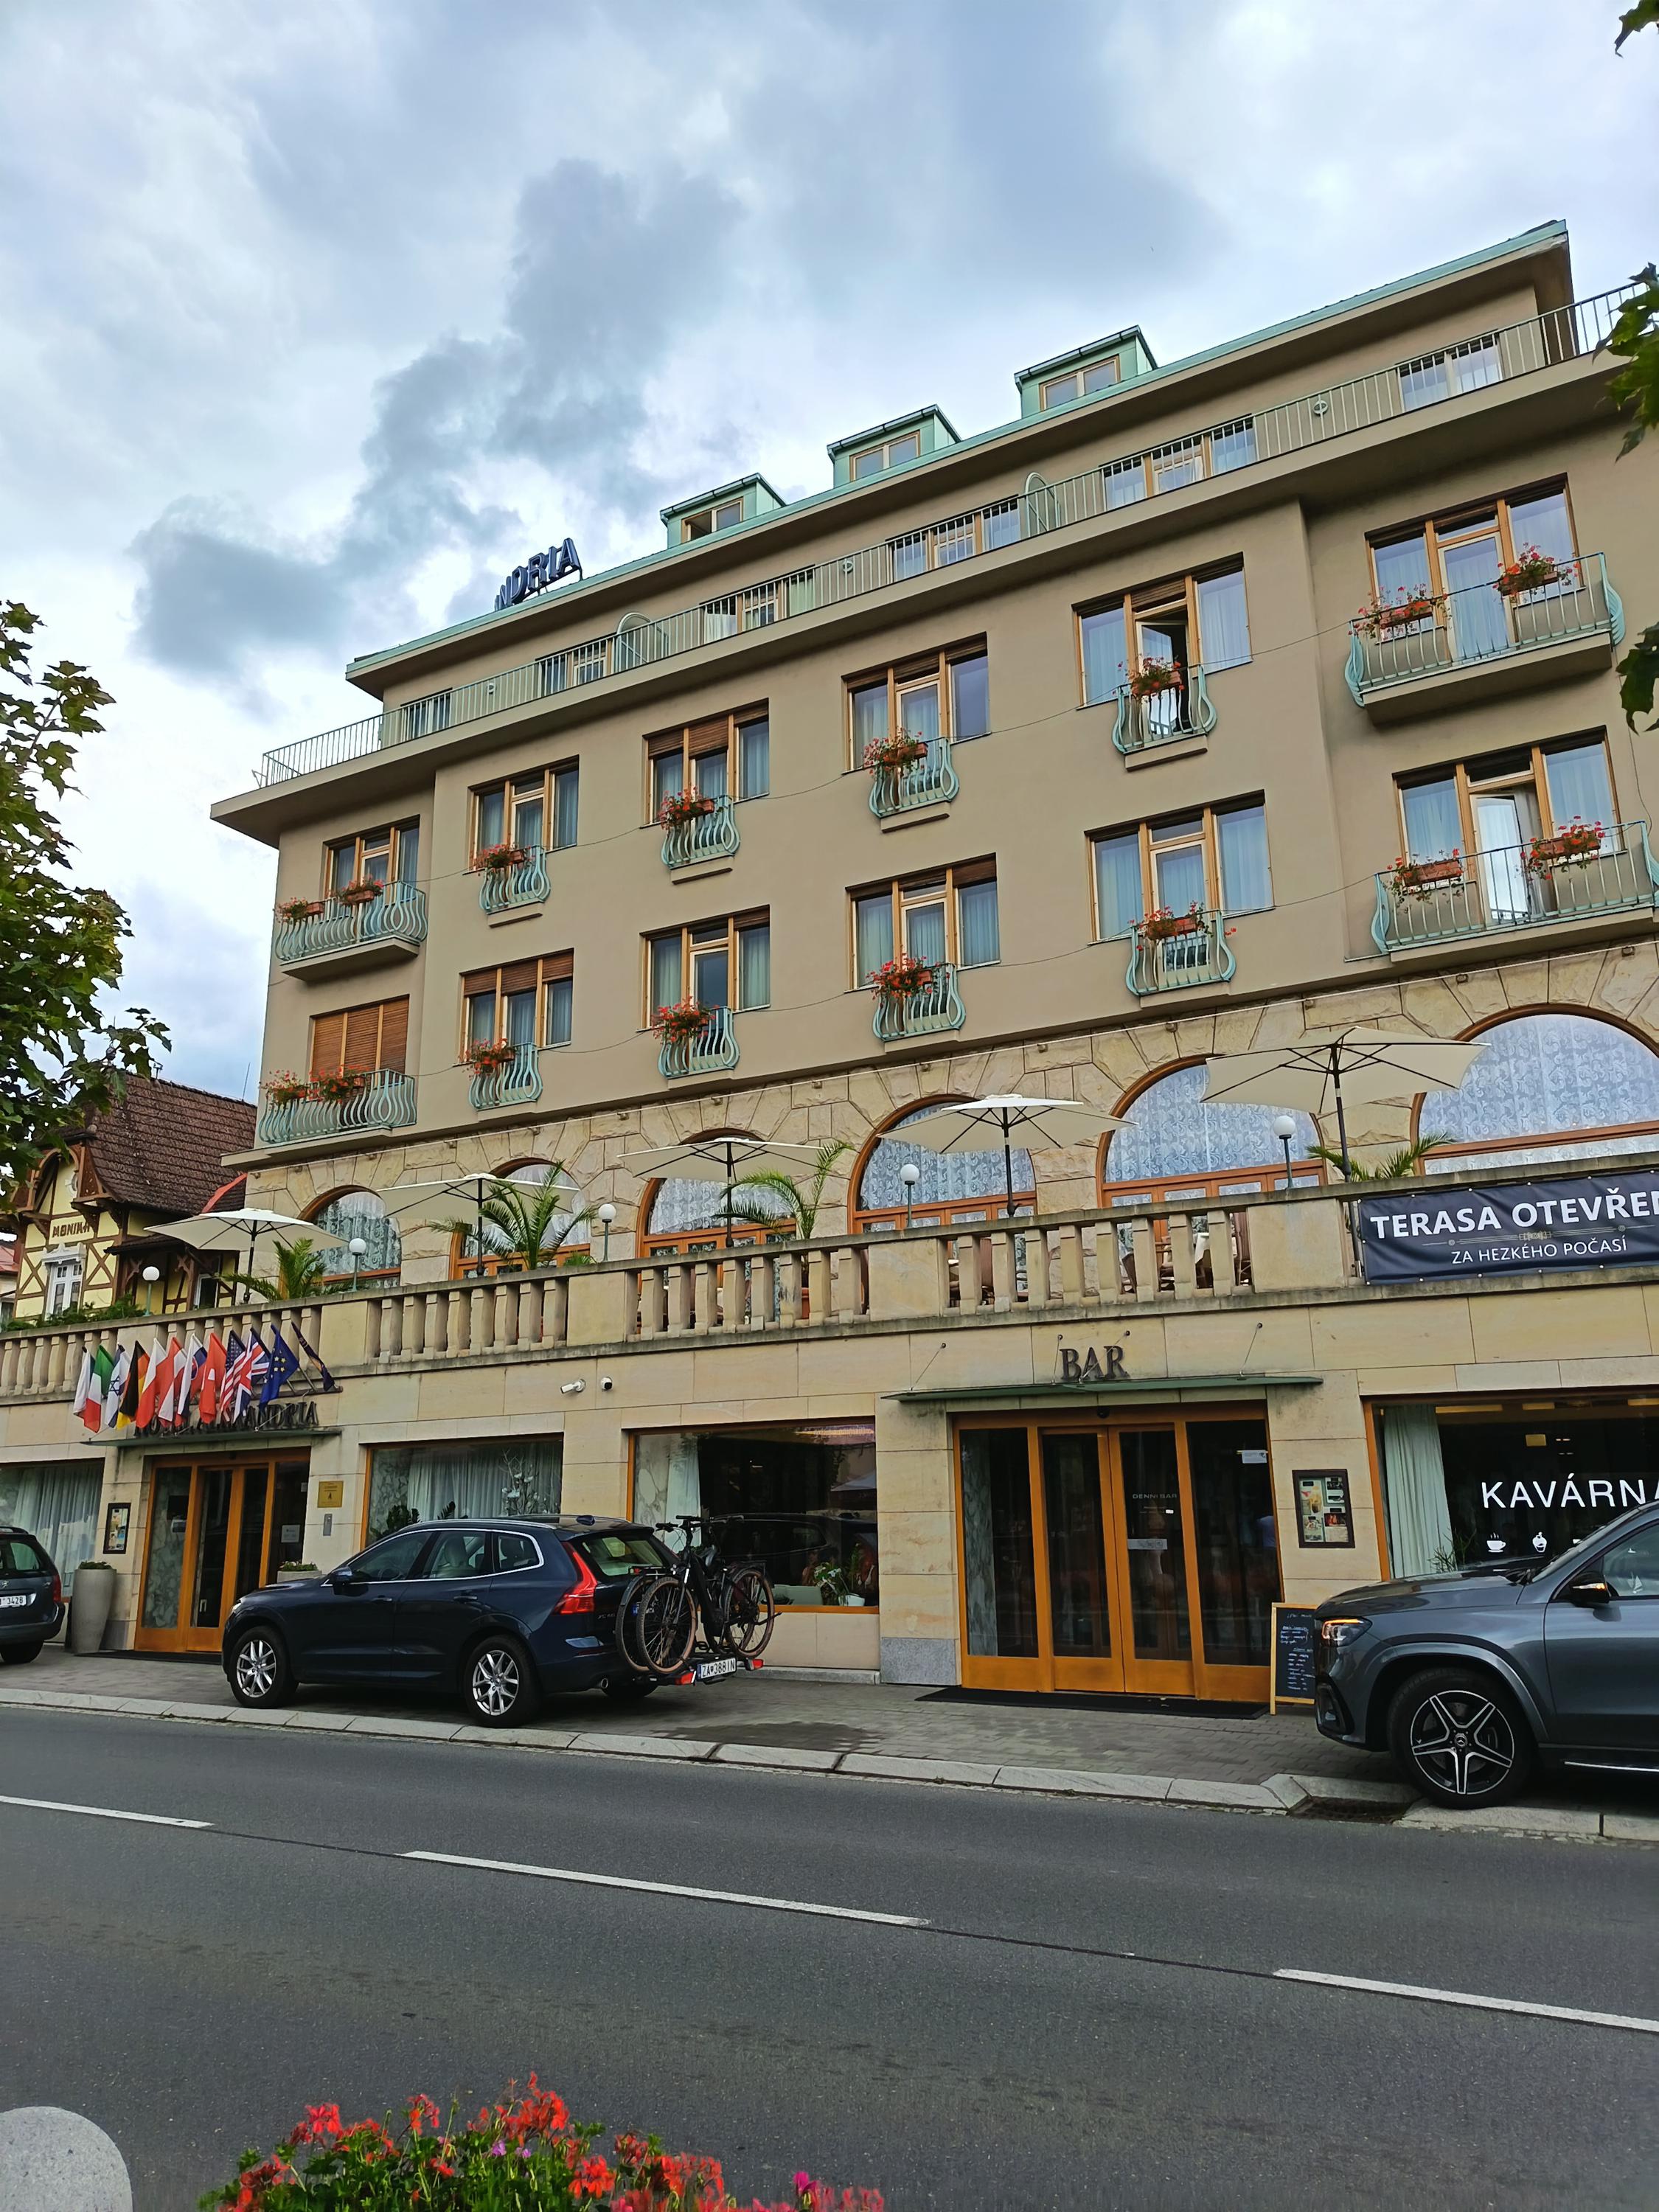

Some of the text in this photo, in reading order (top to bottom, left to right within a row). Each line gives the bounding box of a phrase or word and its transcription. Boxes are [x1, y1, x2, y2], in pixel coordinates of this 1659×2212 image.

[494, 538, 581, 611] NDRIA
[52, 1222, 90, 1238] MONIKA
[1369, 1206, 1502, 1239] TERASA
[1451, 1234, 1627, 1264] ZA HEZKÉHO POČASÍ
[1059, 1346, 1130, 1380] BAR
